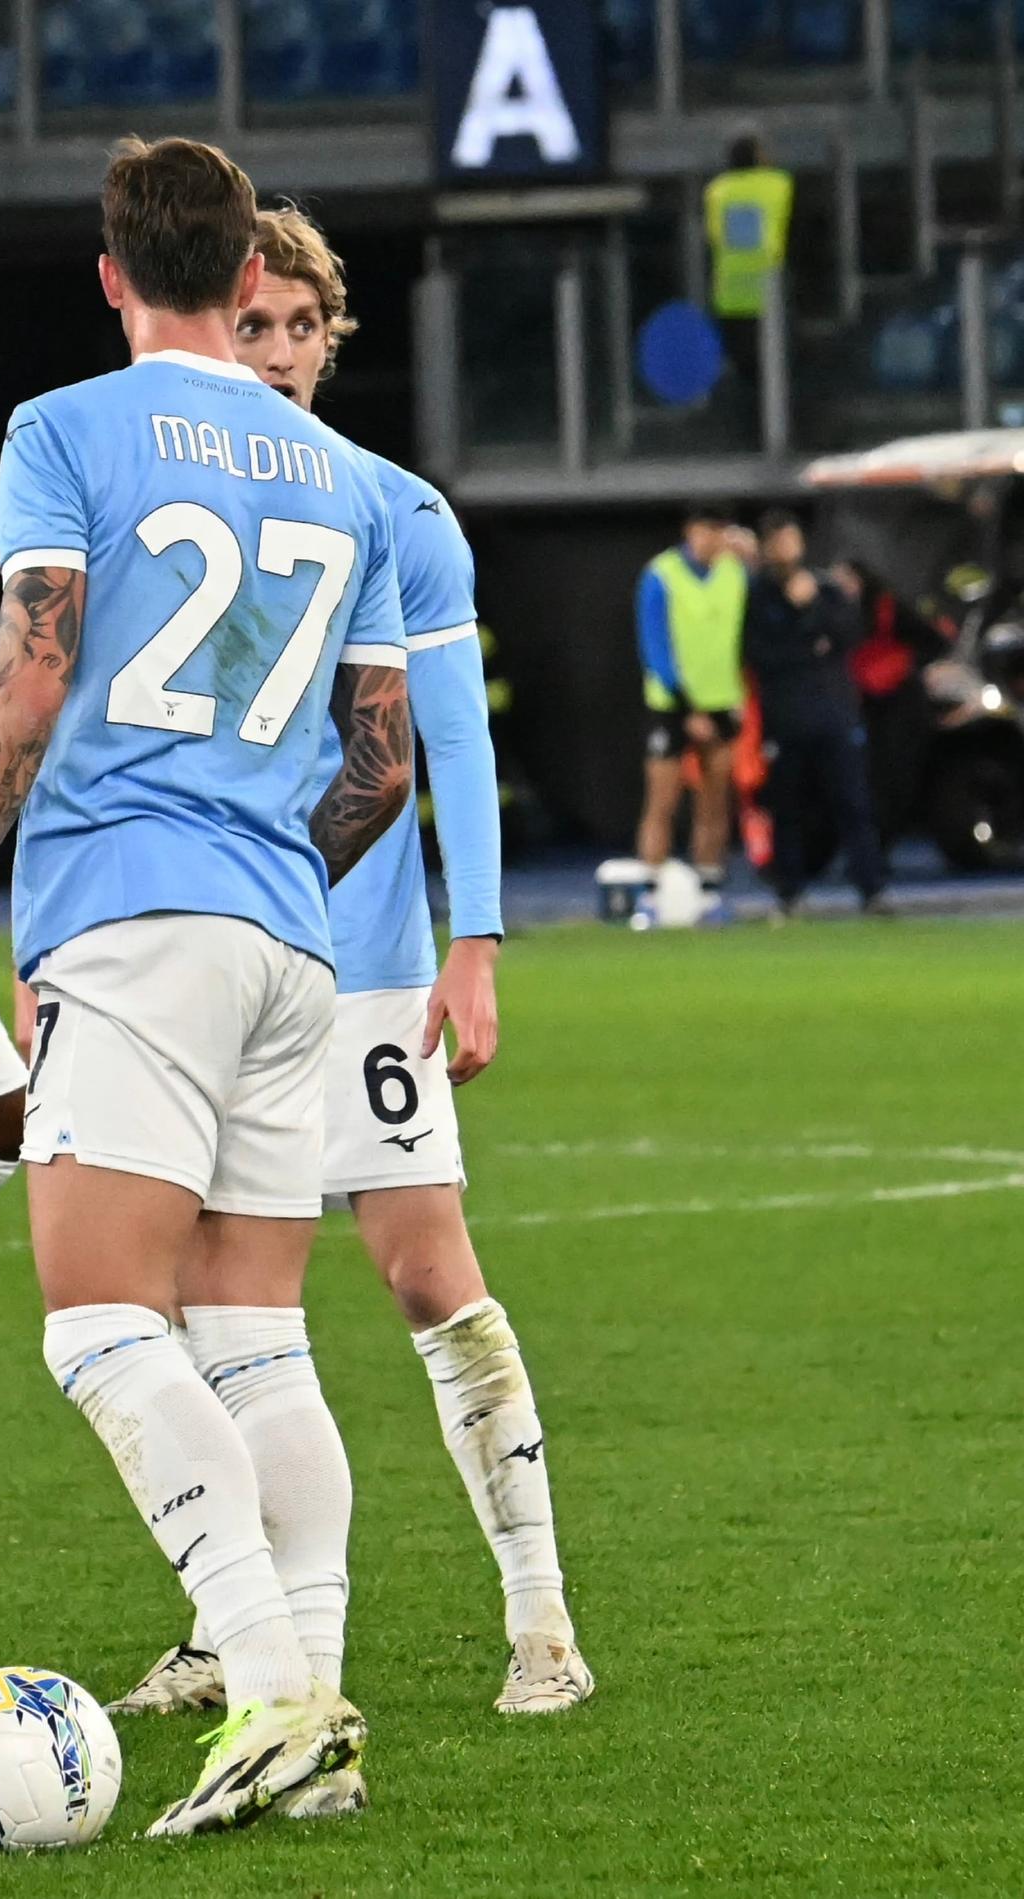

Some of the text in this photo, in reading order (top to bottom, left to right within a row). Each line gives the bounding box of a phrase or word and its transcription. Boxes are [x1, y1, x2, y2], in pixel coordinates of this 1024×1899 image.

[450, 6, 581, 168] A
[150, 413, 334, 493] MALDINI
[105, 501, 355, 747] 27
[363, 1043, 419, 1125] 6
